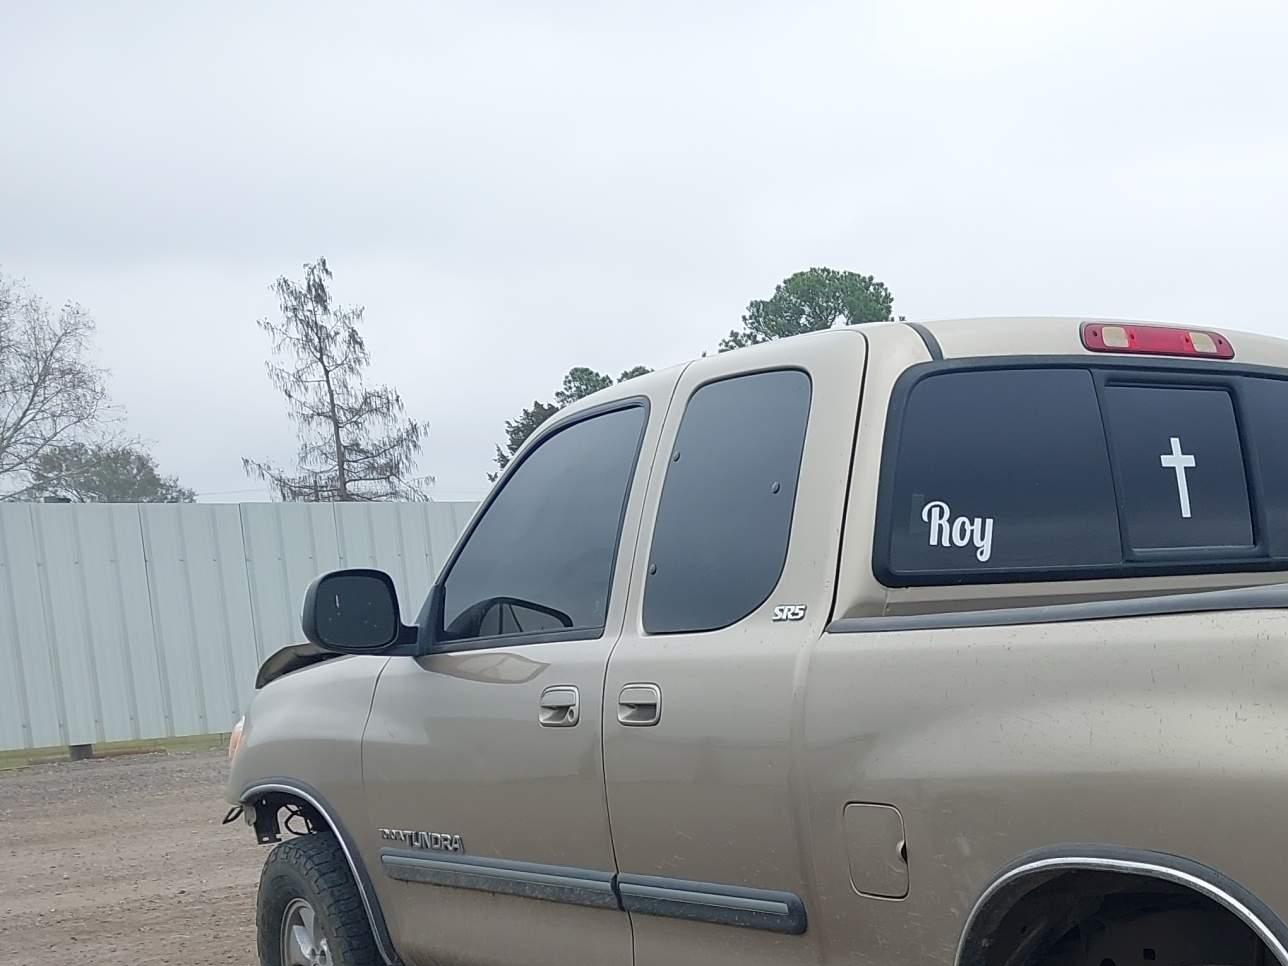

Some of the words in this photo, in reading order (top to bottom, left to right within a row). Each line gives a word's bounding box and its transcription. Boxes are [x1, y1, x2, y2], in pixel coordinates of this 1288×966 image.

[922, 501, 994, 562] Roy
[772, 604, 806, 621] SR5
[404, 830, 465, 853] TUNDRA
